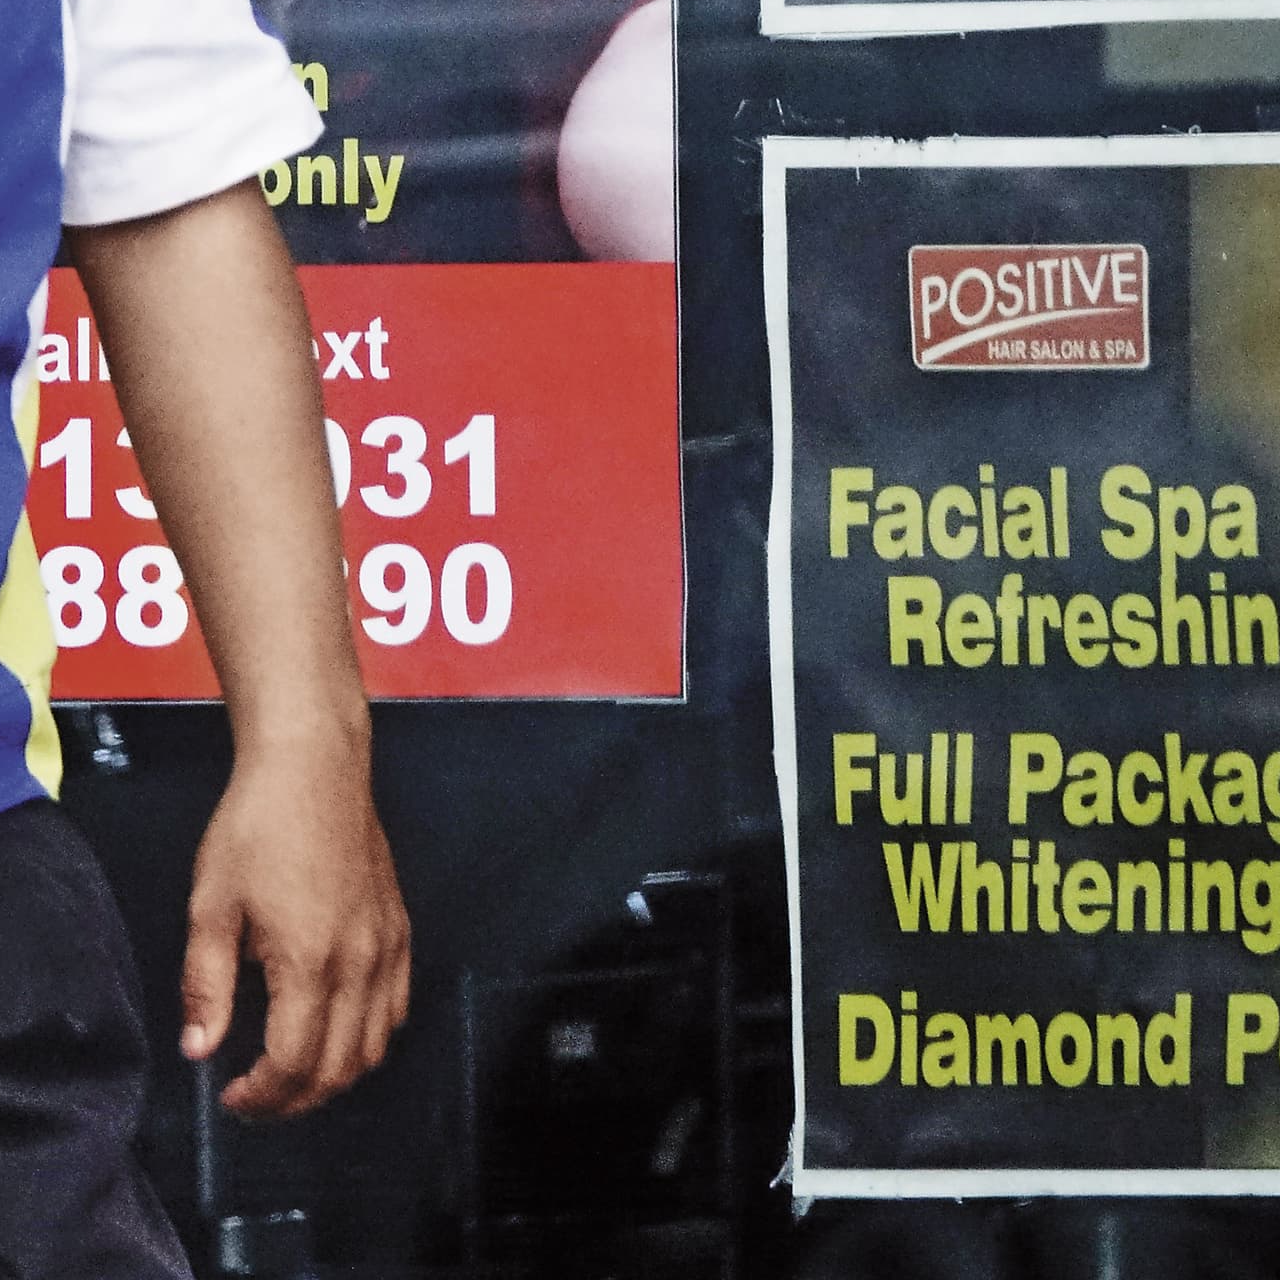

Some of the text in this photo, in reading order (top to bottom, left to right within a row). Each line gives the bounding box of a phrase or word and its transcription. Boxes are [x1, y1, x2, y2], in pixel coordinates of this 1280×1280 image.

[258, 137, 405, 224] only
[920, 252, 1139, 340] POSITIVE
[311, 316, 391, 381] xt
[988, 339, 1137, 360] HAIR SALON & SPA
[829, 463, 1260, 580] Facial Spa
[832, 733, 975, 828] Full
[837, 989, 1194, 1089] Diamond
